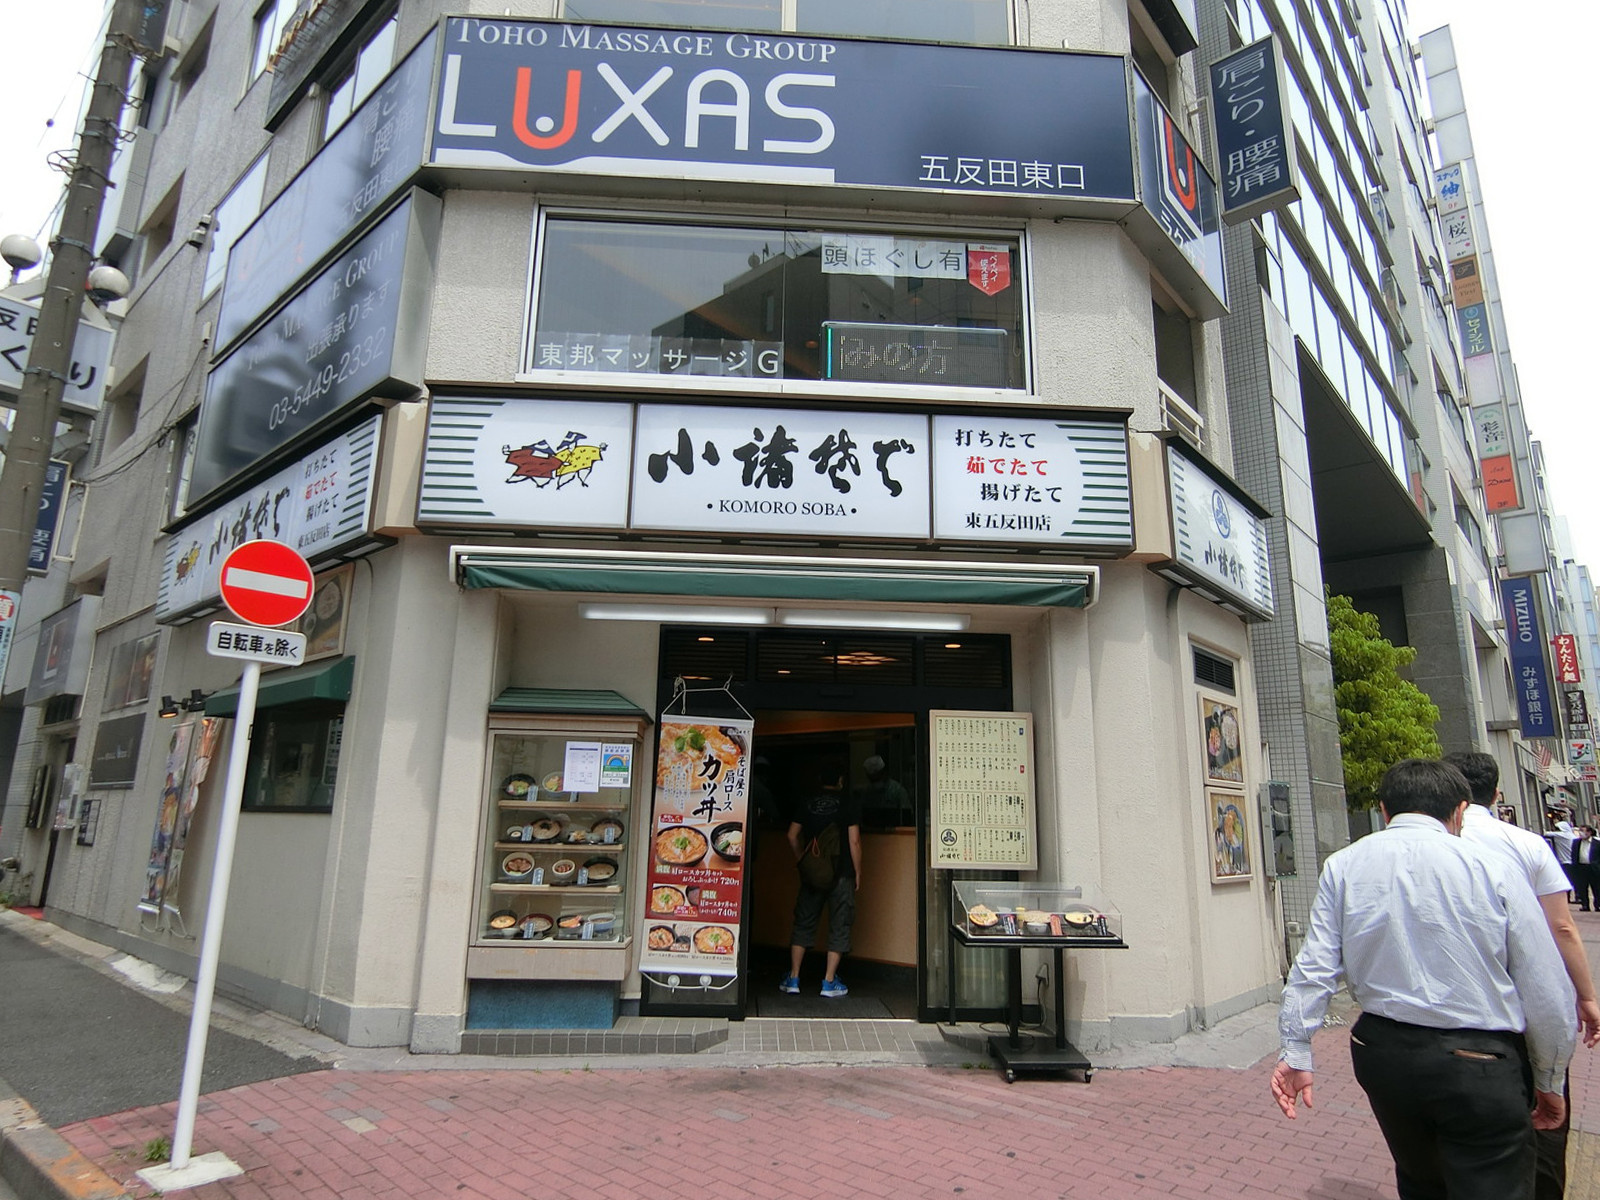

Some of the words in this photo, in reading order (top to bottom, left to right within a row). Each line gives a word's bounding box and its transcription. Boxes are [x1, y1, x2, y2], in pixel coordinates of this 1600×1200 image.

[452, 18, 548, 47] TOHO
[560, 25, 713, 56] MASSAGE
[725, 34, 836, 63] GROUP
[438, 54, 836, 154] LUXAS
[1218, 46, 1281, 199] 肩こり・腰痛
[919, 154, 1087, 191] 五反田東口
[824, 244, 963, 272] 頭ほぐし有
[539, 342, 779, 374] 東邦マッサージG
[268, 326, 387, 431] 03-5449-2332
[954, 428, 1037, 449] 打ちたて
[966, 455, 1049, 476] 茹でたて
[719, 499, 798, 515] KOMORO
[801, 502, 847, 516] SOBA
[980, 483, 1063, 503] 揚げたて
[965, 513, 1051, 532] 東五反田店
[1512, 588, 1533, 643] MIZUHO
[217, 631, 300, 659] 自転車を除く
[1522, 666, 1544, 726] みずほ銀行
[722, 770, 735, 811] 肩ロース
[735, 756, 747, 798] そば屋の
